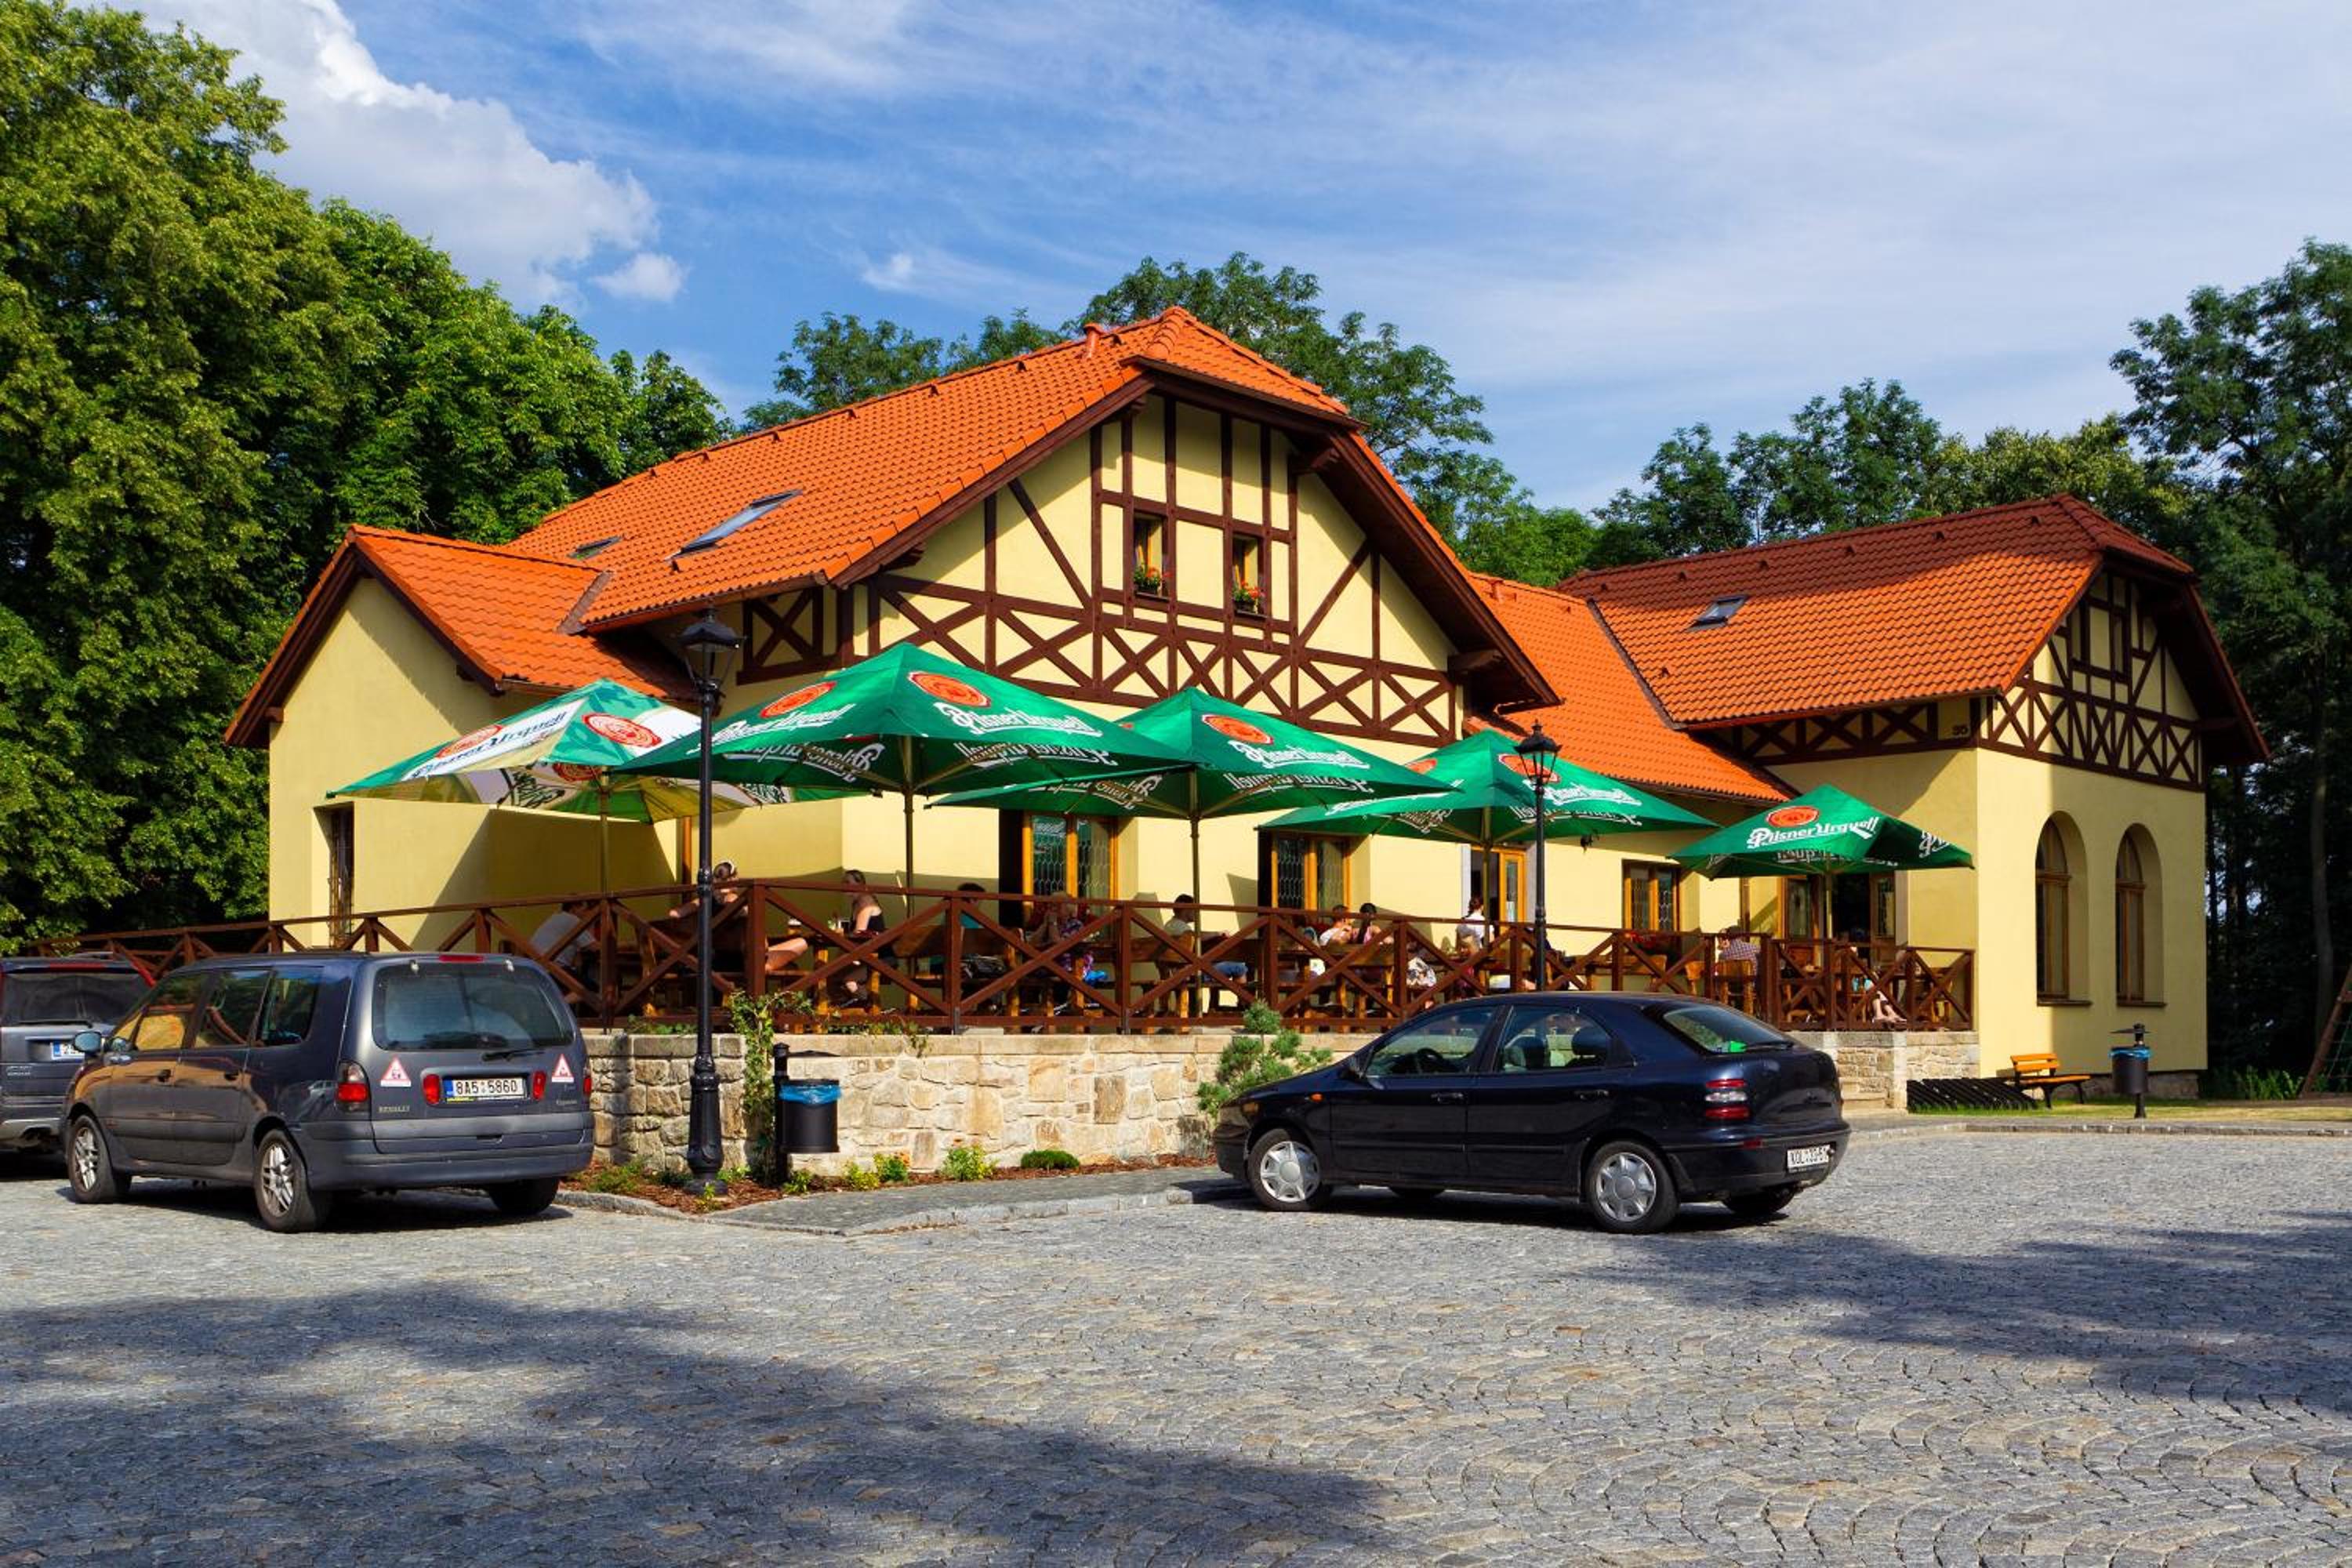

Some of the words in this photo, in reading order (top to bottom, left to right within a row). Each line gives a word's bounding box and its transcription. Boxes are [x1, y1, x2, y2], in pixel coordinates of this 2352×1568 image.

[933, 702, 1024, 735] Pilsner
[1004, 706, 1103, 737] Urquell
[1746, 827, 1815, 849] Pilsner
[1815, 816, 1880, 840] Urquell
